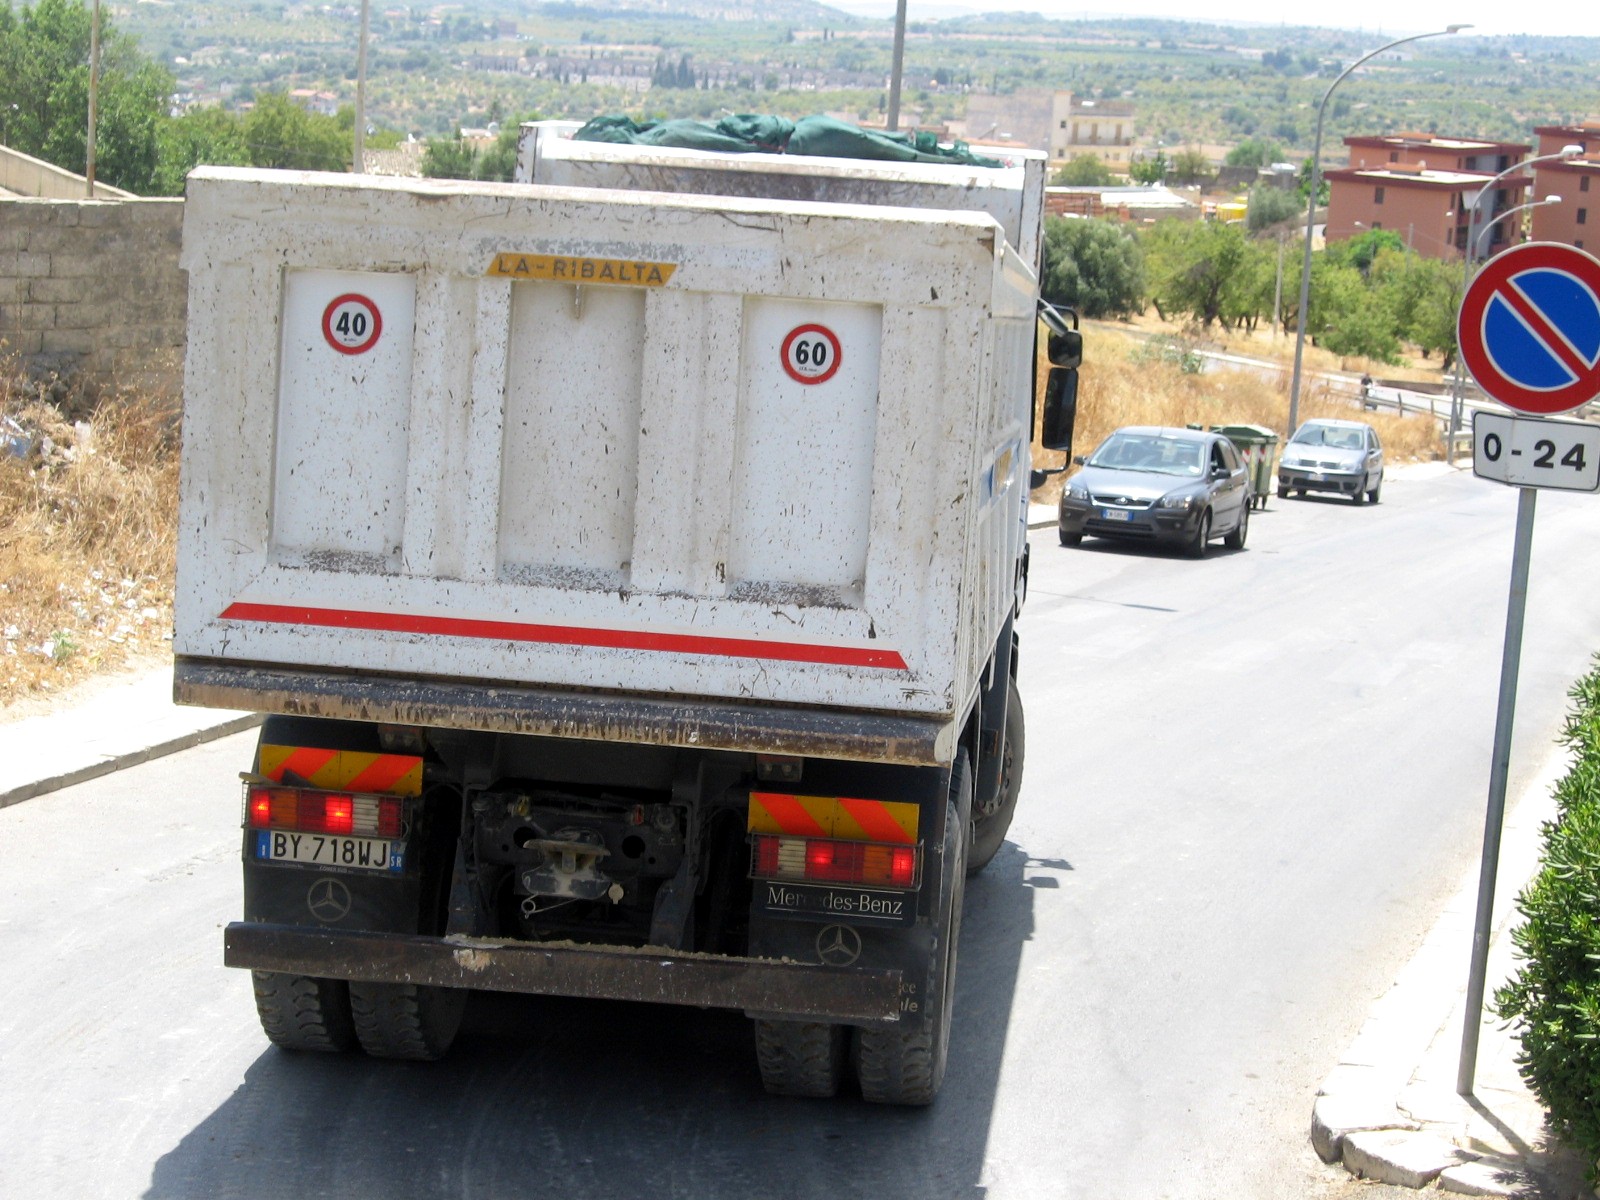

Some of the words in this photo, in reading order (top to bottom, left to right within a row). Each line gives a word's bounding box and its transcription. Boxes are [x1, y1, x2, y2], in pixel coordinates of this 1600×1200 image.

[336, 311, 367, 337] 40
[795, 340, 827, 367] 60
[274, 833, 302, 858] BY
[312, 837, 387, 867] 718WJ
[390, 855, 402, 868] SR
[767, 886, 903, 915] Merdes-Benz
